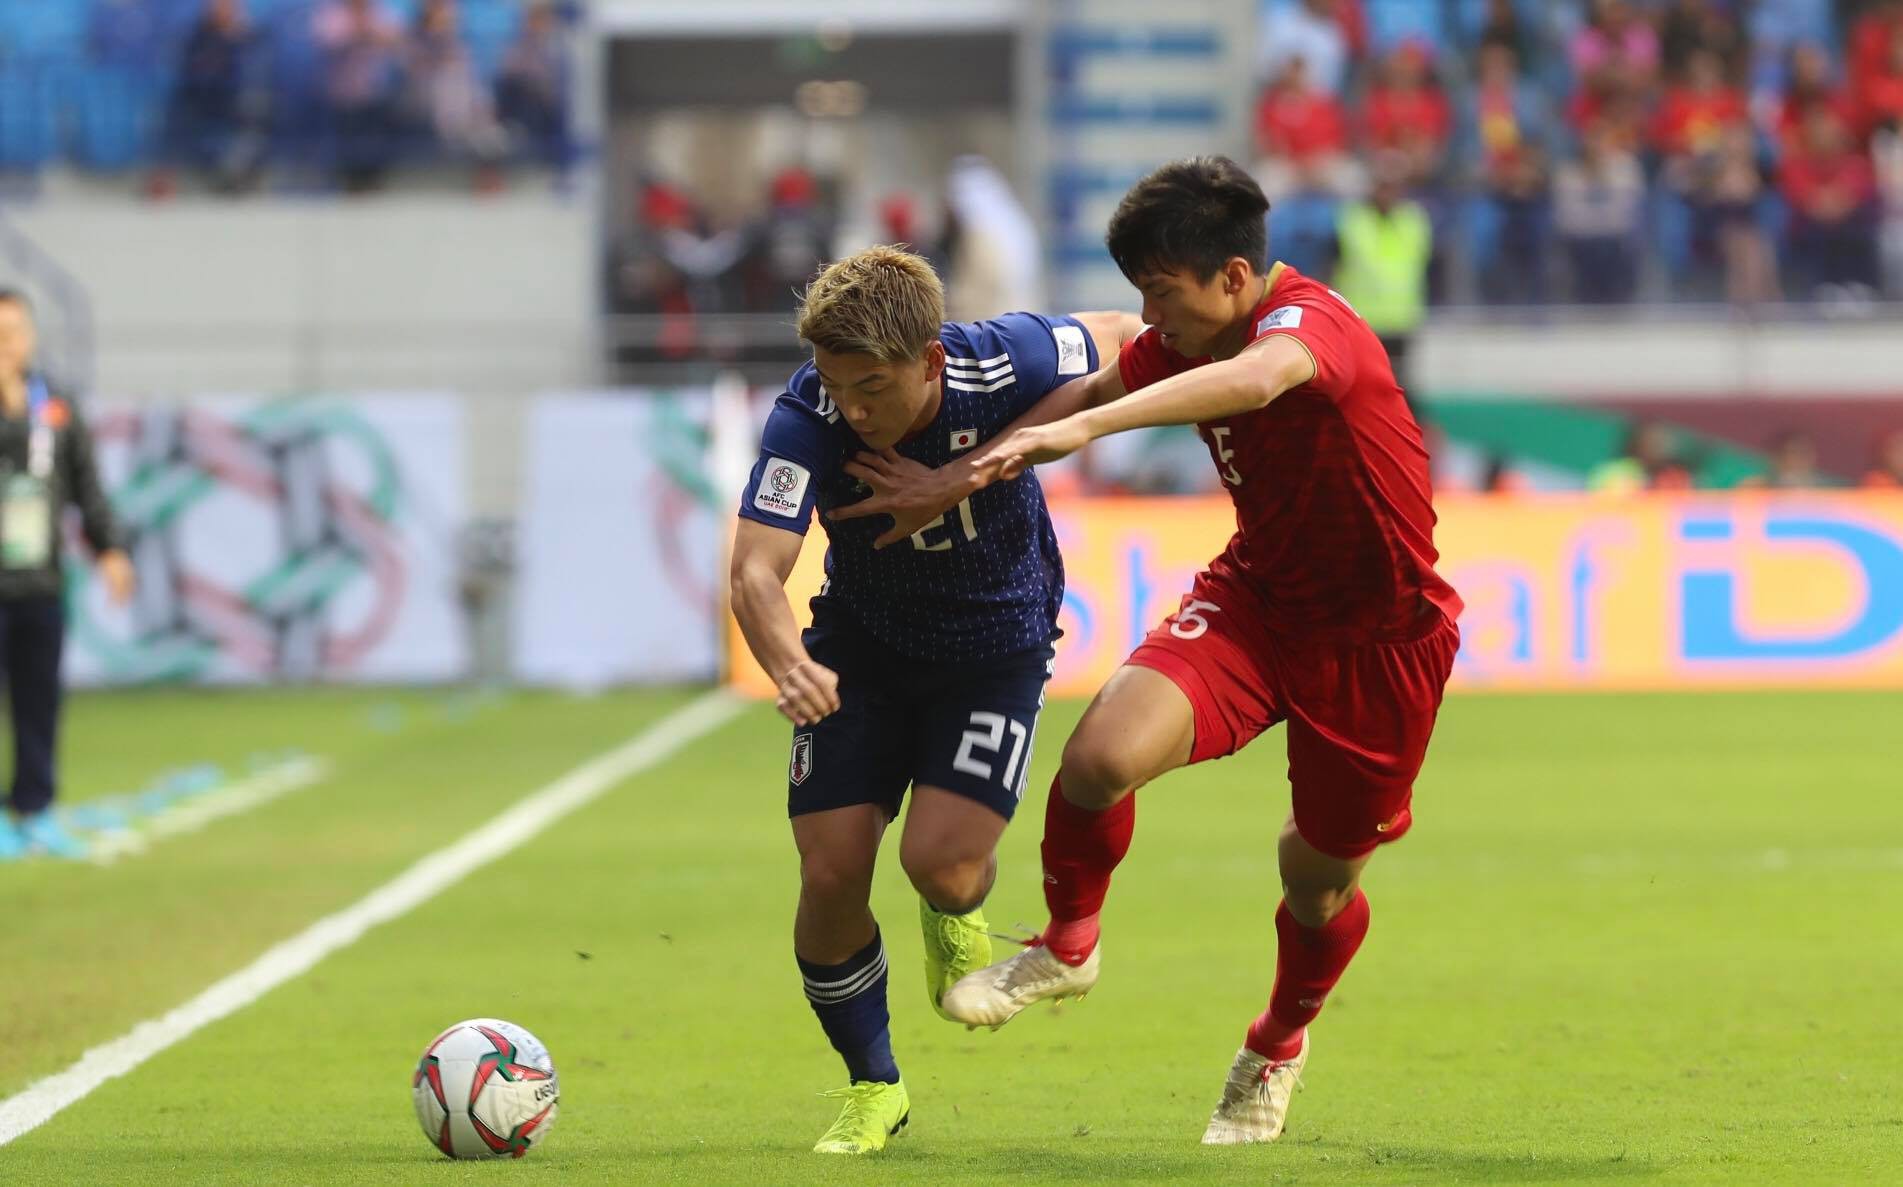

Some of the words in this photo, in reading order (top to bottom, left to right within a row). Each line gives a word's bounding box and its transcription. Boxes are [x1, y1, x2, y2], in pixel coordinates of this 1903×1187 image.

[1211, 426, 1242, 486] 5
[758, 494, 780, 504] ASIAN
[781, 499, 798, 509] CUP
[1170, 599, 1221, 640] 5
[953, 710, 1027, 792] 21
